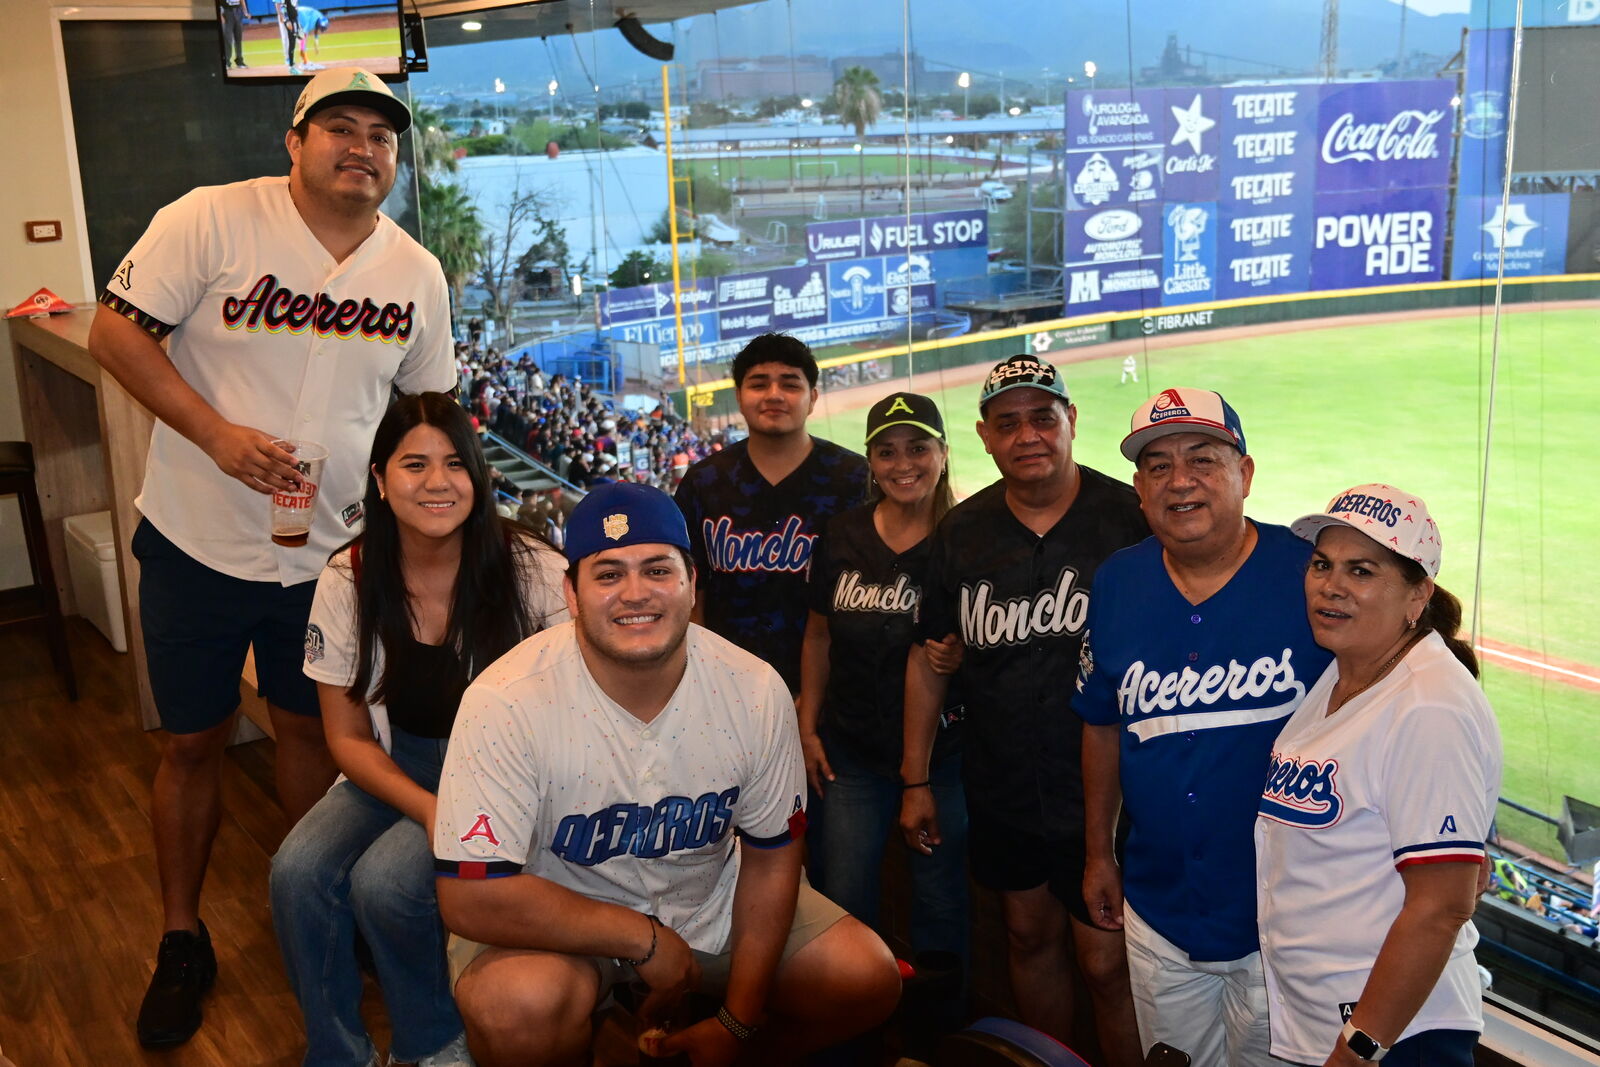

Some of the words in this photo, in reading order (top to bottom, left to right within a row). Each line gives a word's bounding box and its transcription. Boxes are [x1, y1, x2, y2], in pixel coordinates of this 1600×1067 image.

[1232, 91, 1298, 119] TECATE
[1232, 131, 1298, 158] TECATE
[1321, 109, 1445, 164] Coca-Cola
[1230, 172, 1296, 200] TECATE
[885, 223, 929, 249] FUEL
[932, 218, 983, 245] STOP
[1097, 215, 1129, 234] Ford
[1230, 213, 1294, 242] TECATE
[1316, 211, 1433, 249] POWER
[1173, 262, 1206, 280] Little
[1229, 253, 1294, 283] TECATE
[1365, 242, 1432, 277] ADE
[1163, 276, 1211, 295] Caesars
[222, 273, 414, 346] Acereros
[1157, 311, 1214, 330] FIBRANET
[885, 397, 914, 416] A
[272, 493, 313, 509] TECATE
[1328, 493, 1402, 528] ACEREROS
[1117, 648, 1298, 715] Acereros
[459, 812, 501, 848] A
[551, 785, 740, 867] ACEREROS
